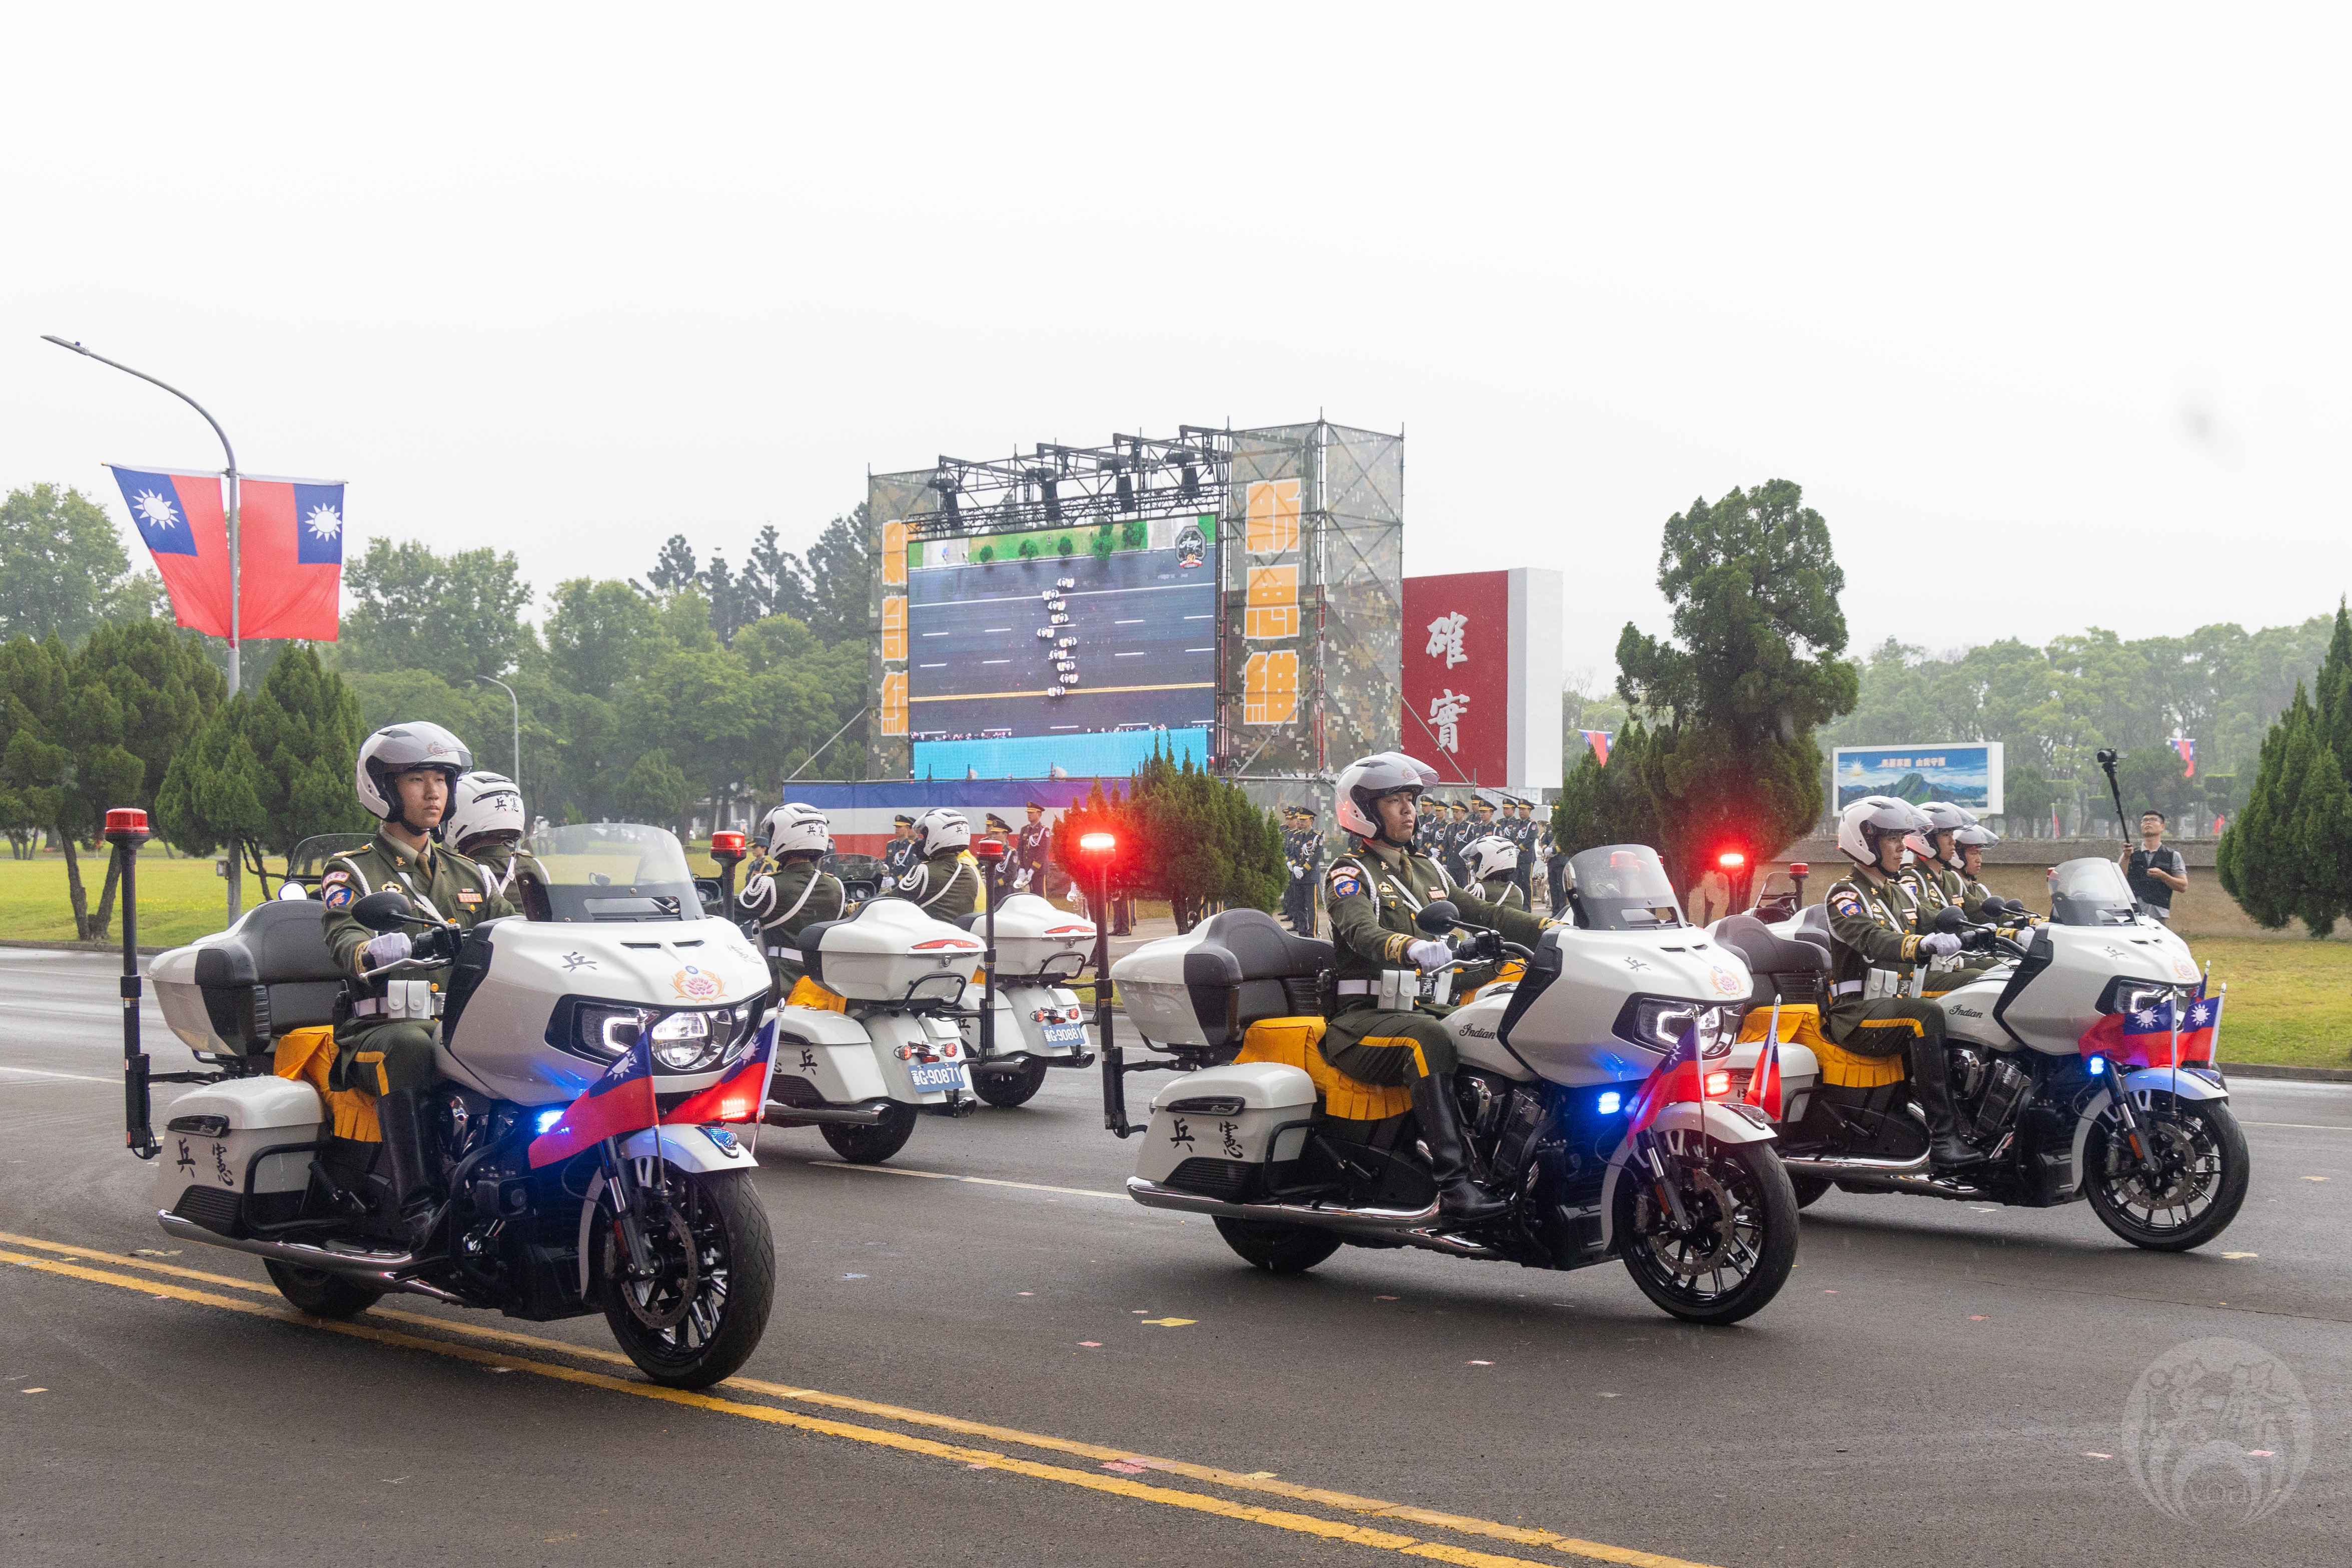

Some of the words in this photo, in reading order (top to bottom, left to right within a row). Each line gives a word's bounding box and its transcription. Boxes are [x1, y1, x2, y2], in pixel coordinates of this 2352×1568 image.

[1186, 553, 1196, 564] 80
[1949, 1004, 1983, 1018] Indian
[1459, 1023, 1496, 1040] Indian
